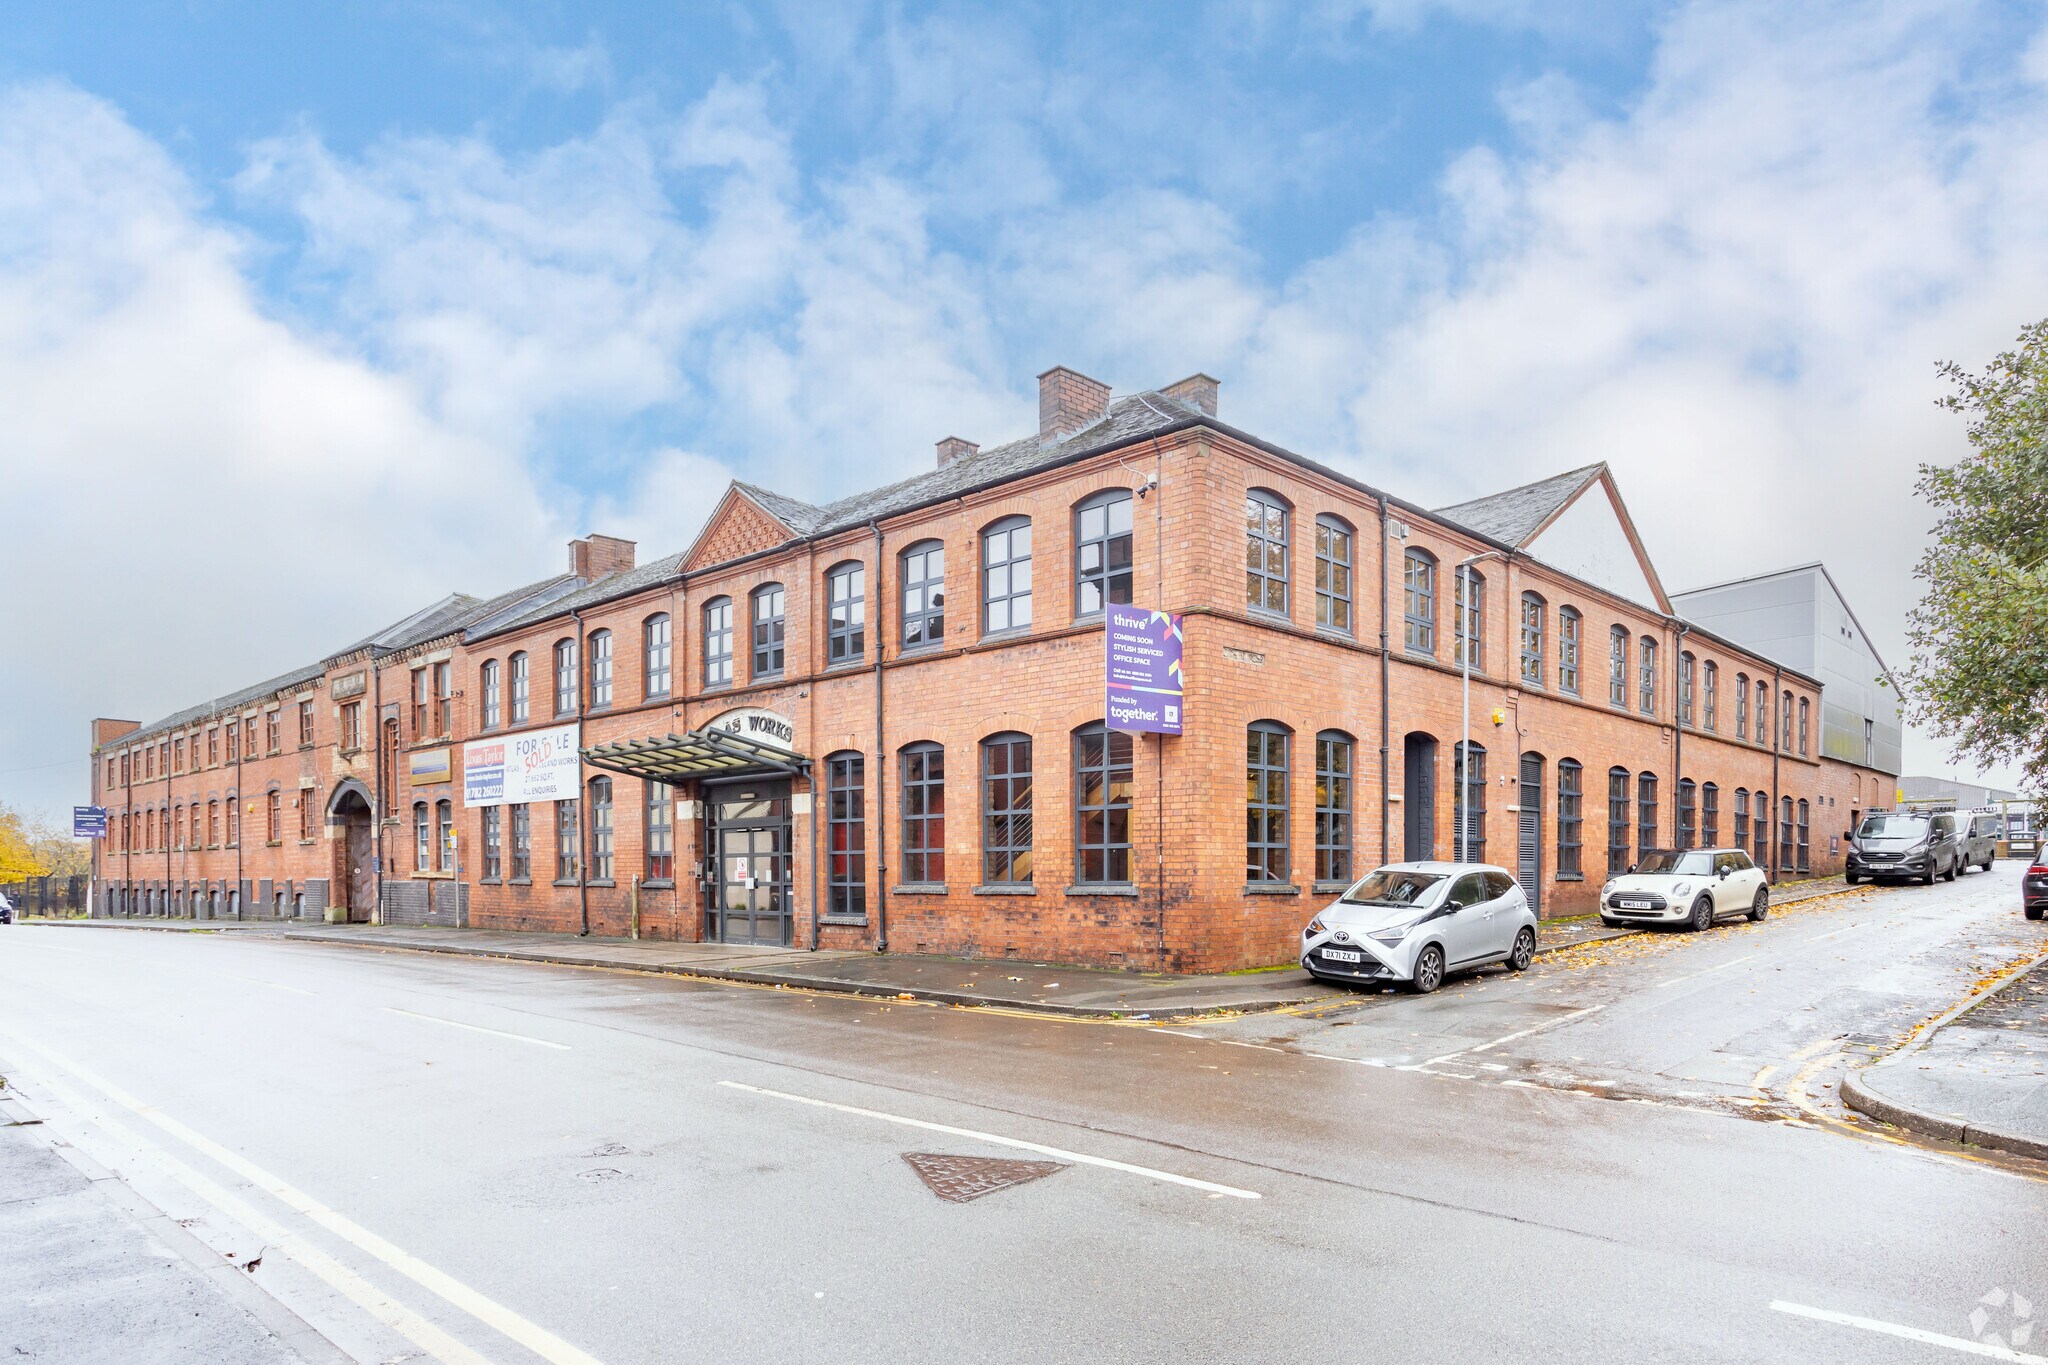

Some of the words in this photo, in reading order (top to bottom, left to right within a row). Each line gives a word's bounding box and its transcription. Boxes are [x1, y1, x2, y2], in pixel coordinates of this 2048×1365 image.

[1113, 614, 1146, 630] thrive
[1113, 633, 1136, 643] COMING
[1137, 637, 1153, 645] SOON
[1113, 643, 1136, 653] STYLISH
[1137, 647, 1163, 656] SERVICED
[1113, 654, 1132, 663] OFFICE
[1134, 657, 1150, 666] SPACE
[1111, 695, 1130, 704] Funded
[1131, 697, 1137, 706] by
[748, 716, 793, 743] WORKS
[516, 738, 537, 756] FOR
[542, 733, 569, 750] LE
[466, 750, 483, 766] Louis
[483, 746, 504, 767] Taylor
[525, 741, 552, 773] SOLD
[558, 756, 578, 766] WORKS
[532, 784, 557, 795] ENQUIRIES
[1326, 950, 1341, 959] DX71
[1342, 952, 1356, 961] ZXJ
